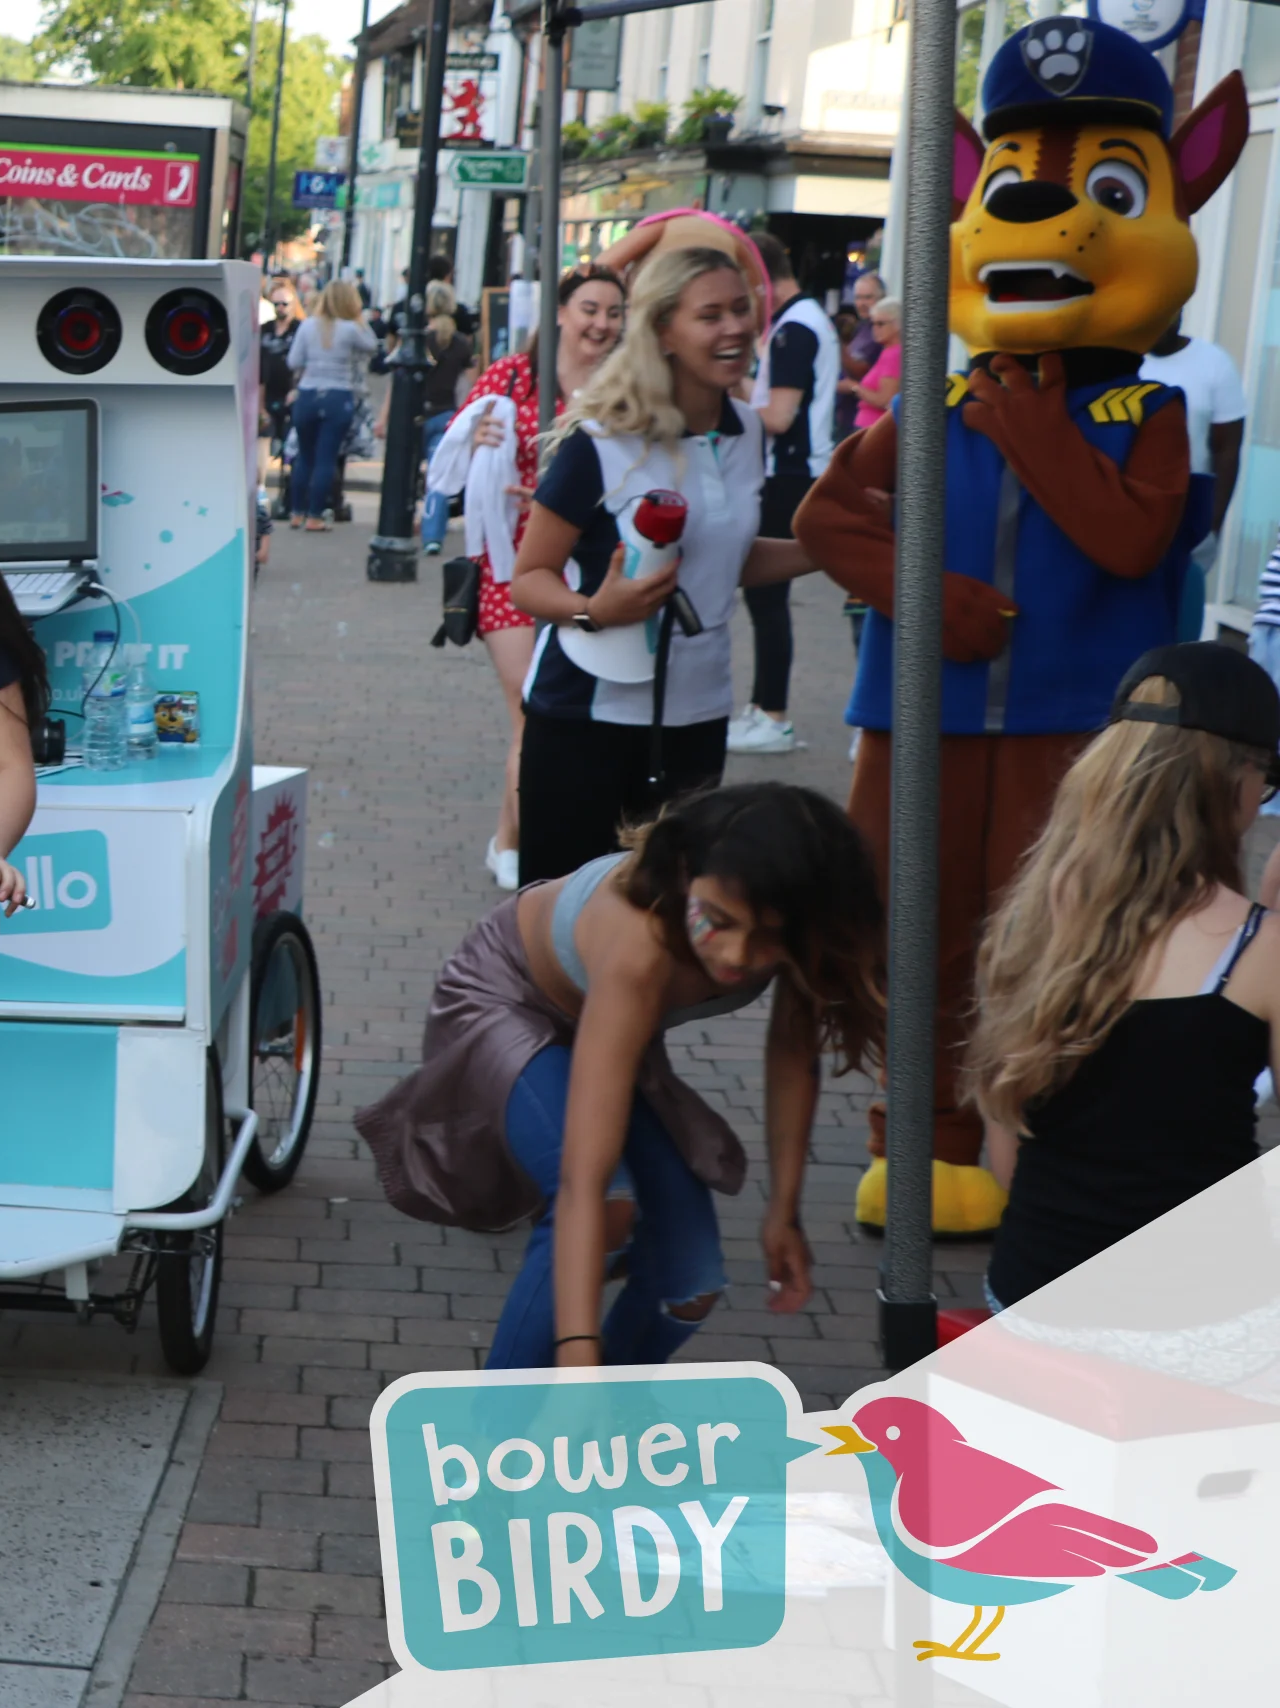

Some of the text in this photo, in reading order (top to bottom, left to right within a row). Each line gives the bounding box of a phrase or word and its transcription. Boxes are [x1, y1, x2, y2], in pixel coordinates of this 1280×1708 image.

[56, 163, 79, 188] &
[81, 161, 153, 192] Cards
[158, 643, 190, 670] IT
